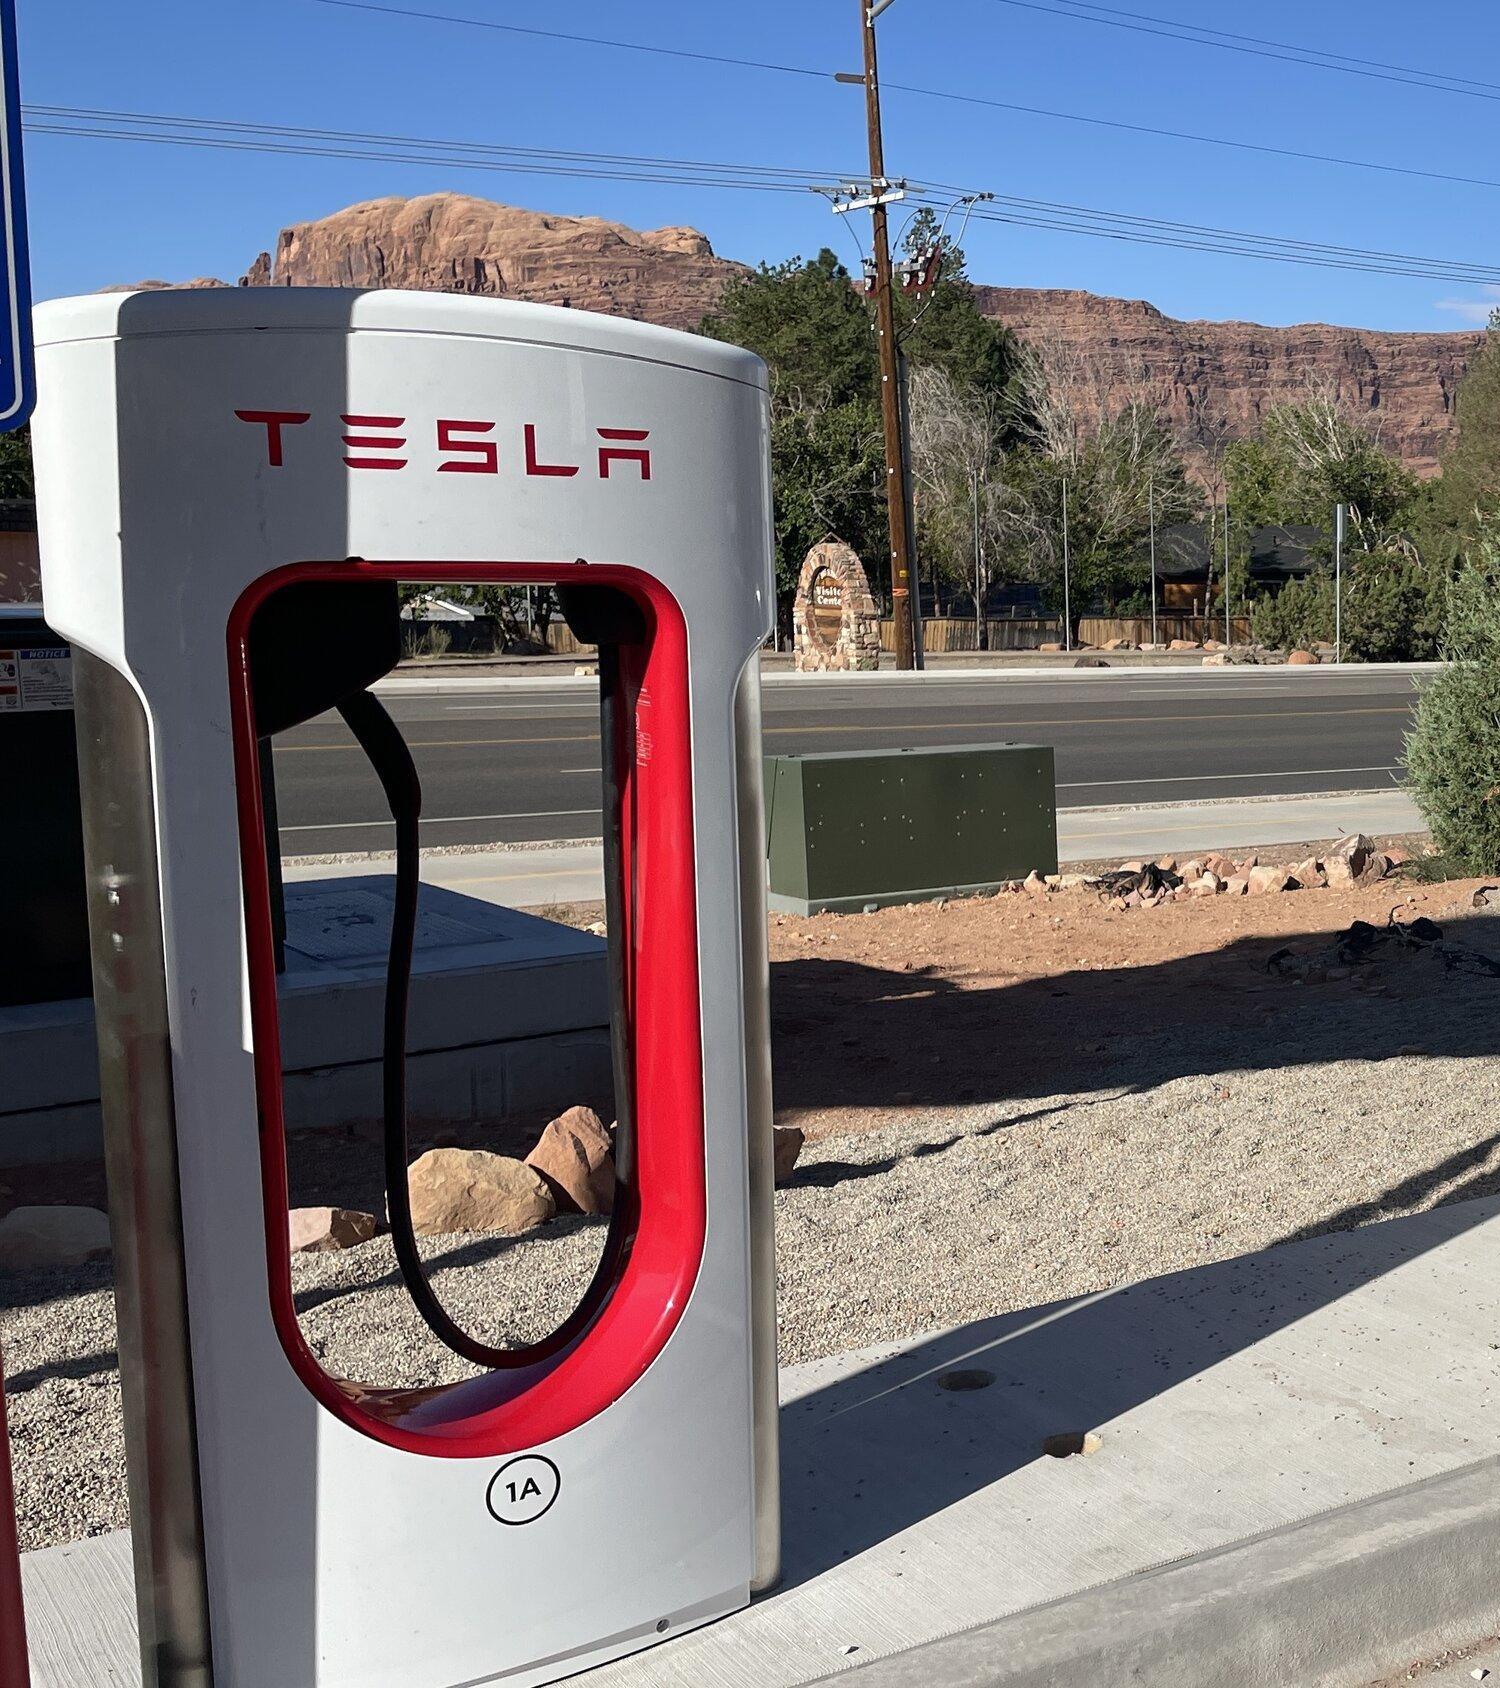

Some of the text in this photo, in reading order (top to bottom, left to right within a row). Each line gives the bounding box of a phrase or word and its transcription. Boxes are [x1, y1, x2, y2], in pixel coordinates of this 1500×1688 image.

[234, 410, 652, 480] TESLA
[29, 649, 66, 659] NOTICE
[505, 1477, 542, 1503] 1A
